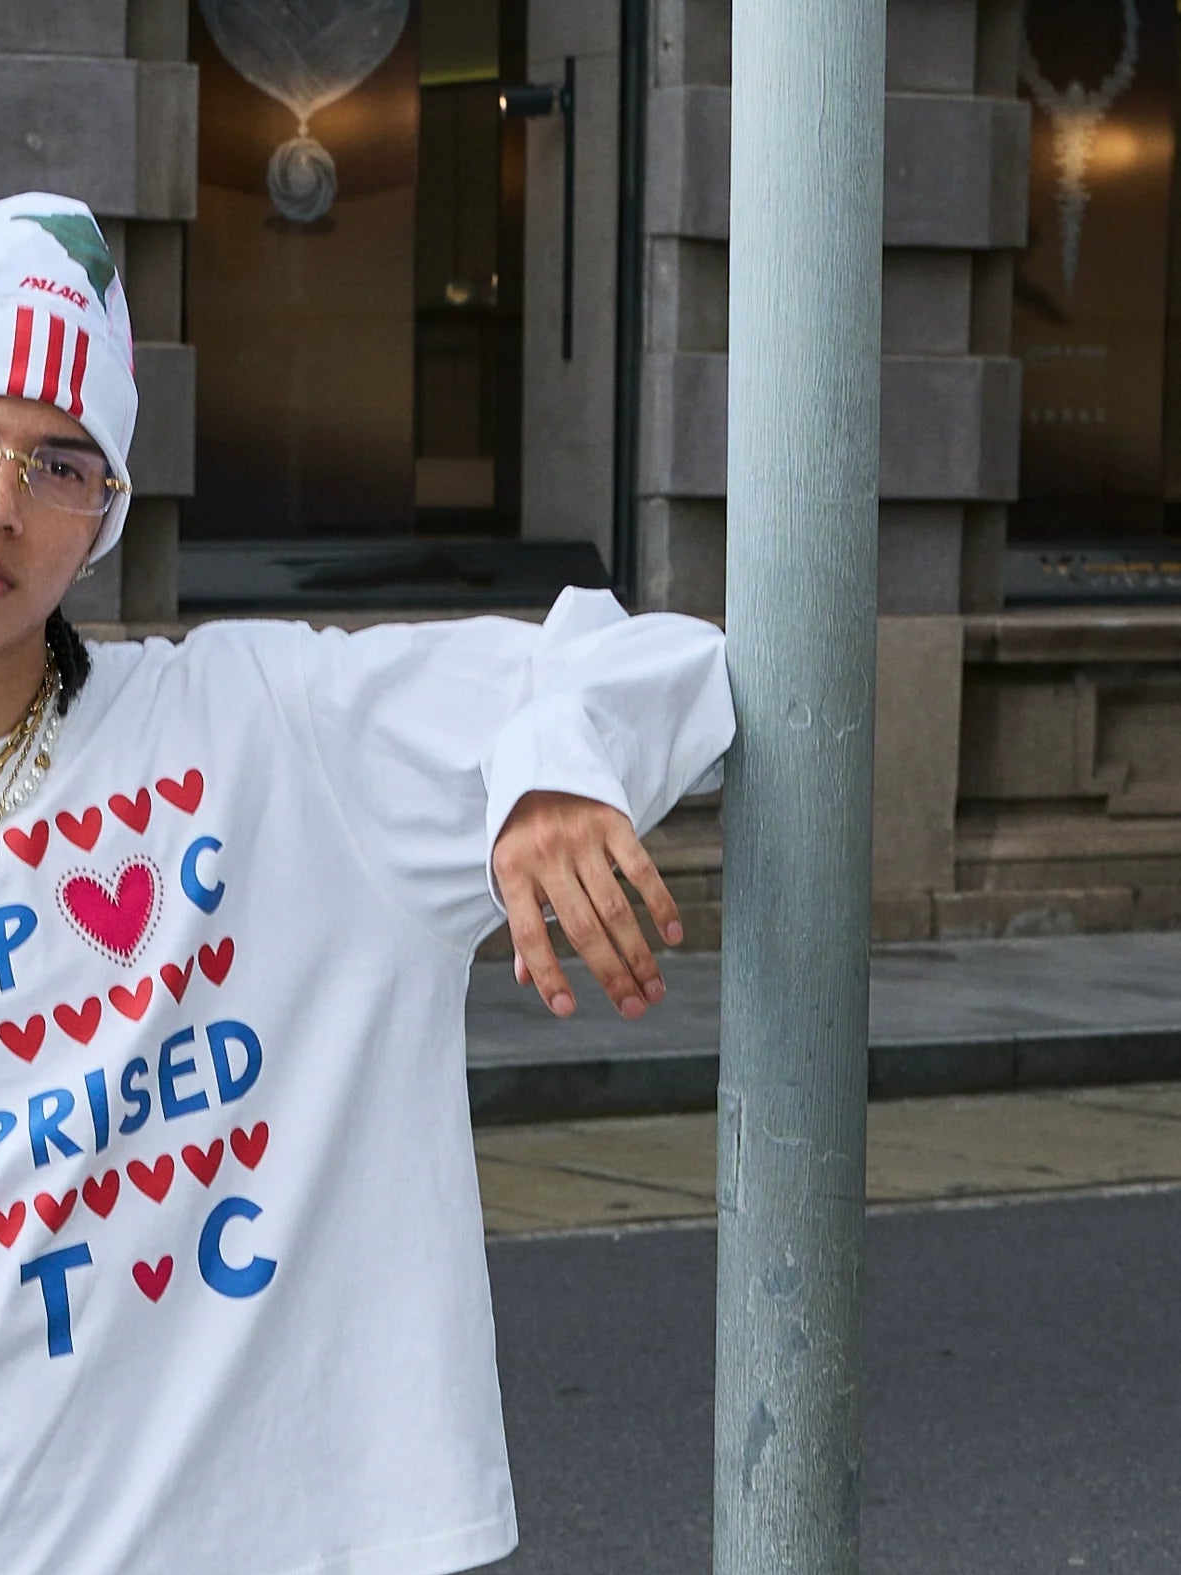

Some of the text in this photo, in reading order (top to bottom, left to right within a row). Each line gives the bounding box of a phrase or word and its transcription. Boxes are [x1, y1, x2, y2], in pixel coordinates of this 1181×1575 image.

[19, 276, 90, 312] PALACE
[180, 835, 225, 915] C
[20, 1242, 93, 1358] T
[197, 1196, 278, 1299] C
